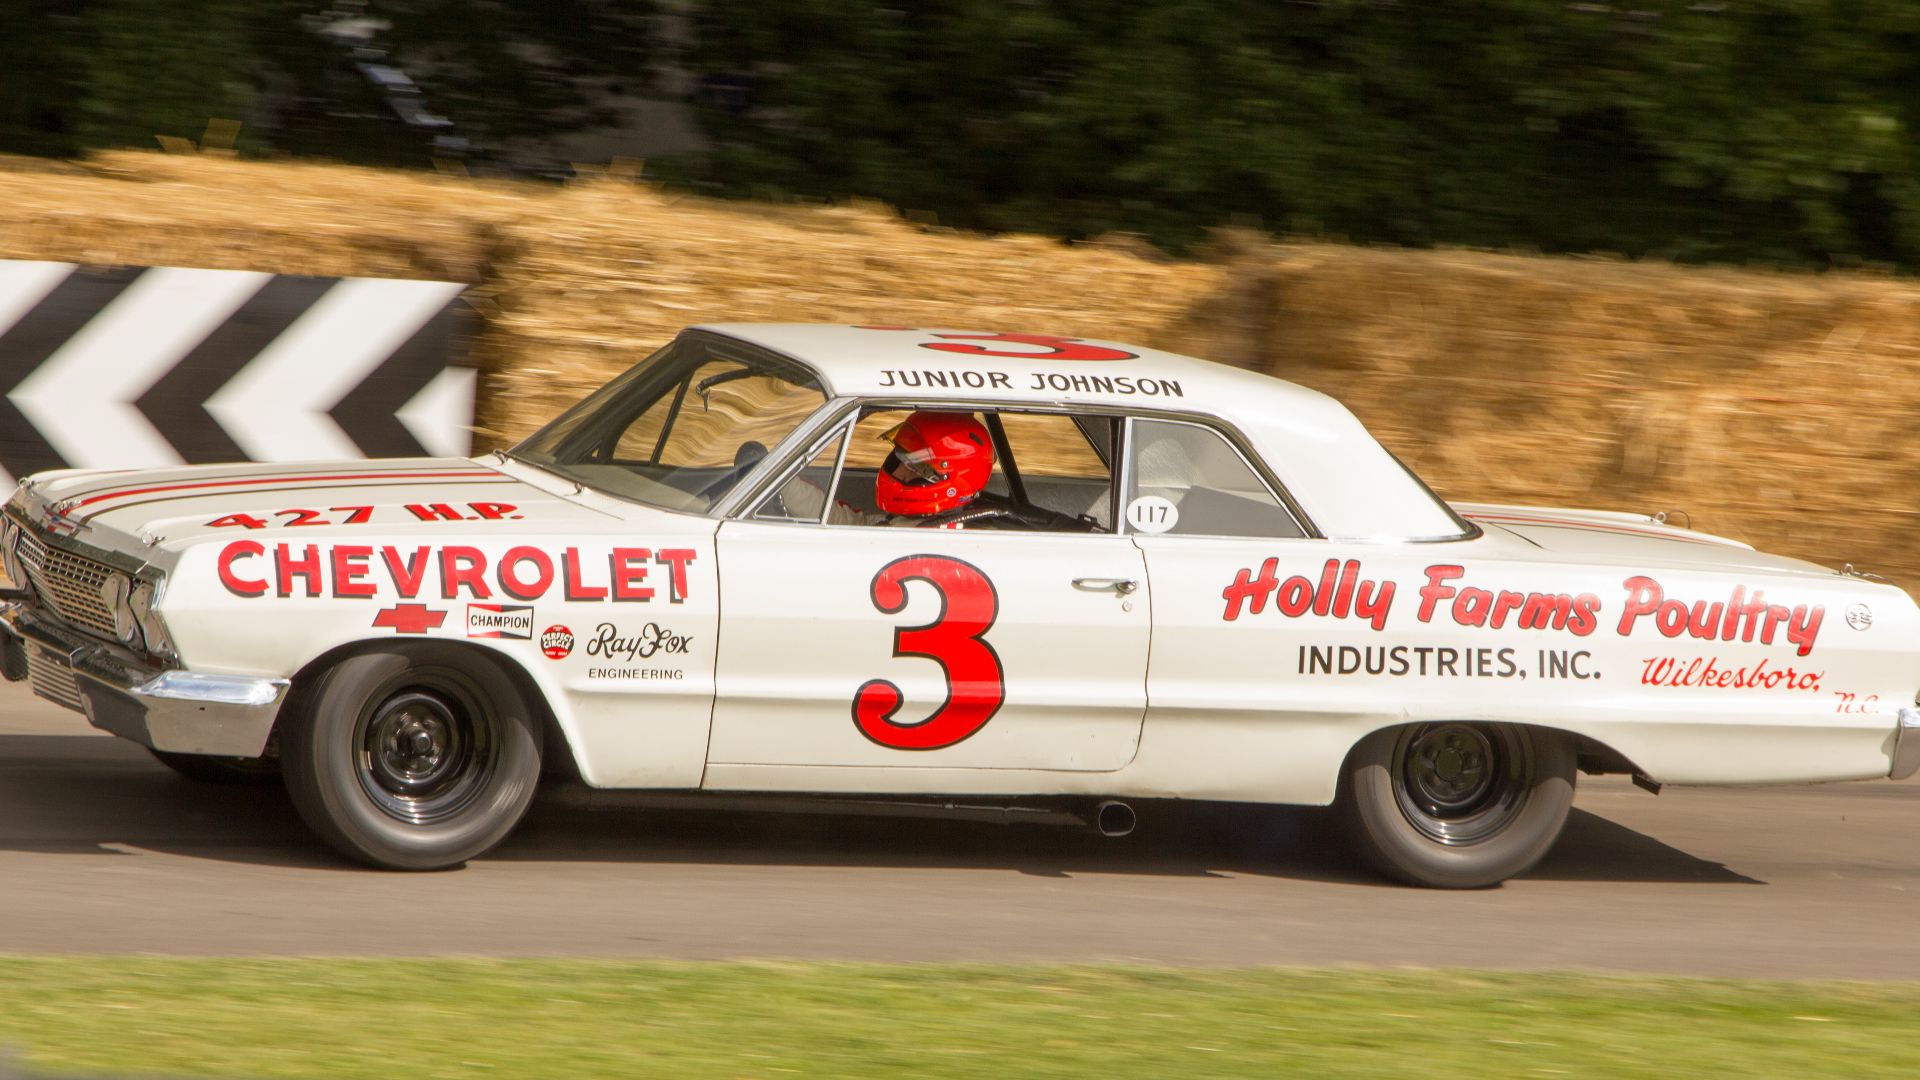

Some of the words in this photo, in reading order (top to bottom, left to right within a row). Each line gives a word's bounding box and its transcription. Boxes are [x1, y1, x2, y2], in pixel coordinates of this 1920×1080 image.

[878, 369, 1014, 390] JUNIOR
[1030, 372, 1184, 398] JOHNSON
[204, 505, 375, 529] 427
[403, 502, 525, 522] H.P.
[1136, 505, 1168, 525] 117
[217, 540, 697, 603] CHEVROLET
[470, 614, 530, 629] CHAMPION
[1222, 557, 1397, 632] Holly
[1417, 564, 1602, 637] Farms
[1616, 575, 1826, 657] Poultry
[851, 553, 1006, 751] 3
[1297, 645, 1528, 680] INDUSTRIES,
[1539, 649, 1602, 680] INC.
[588, 668, 683, 680] ENGINEERING
